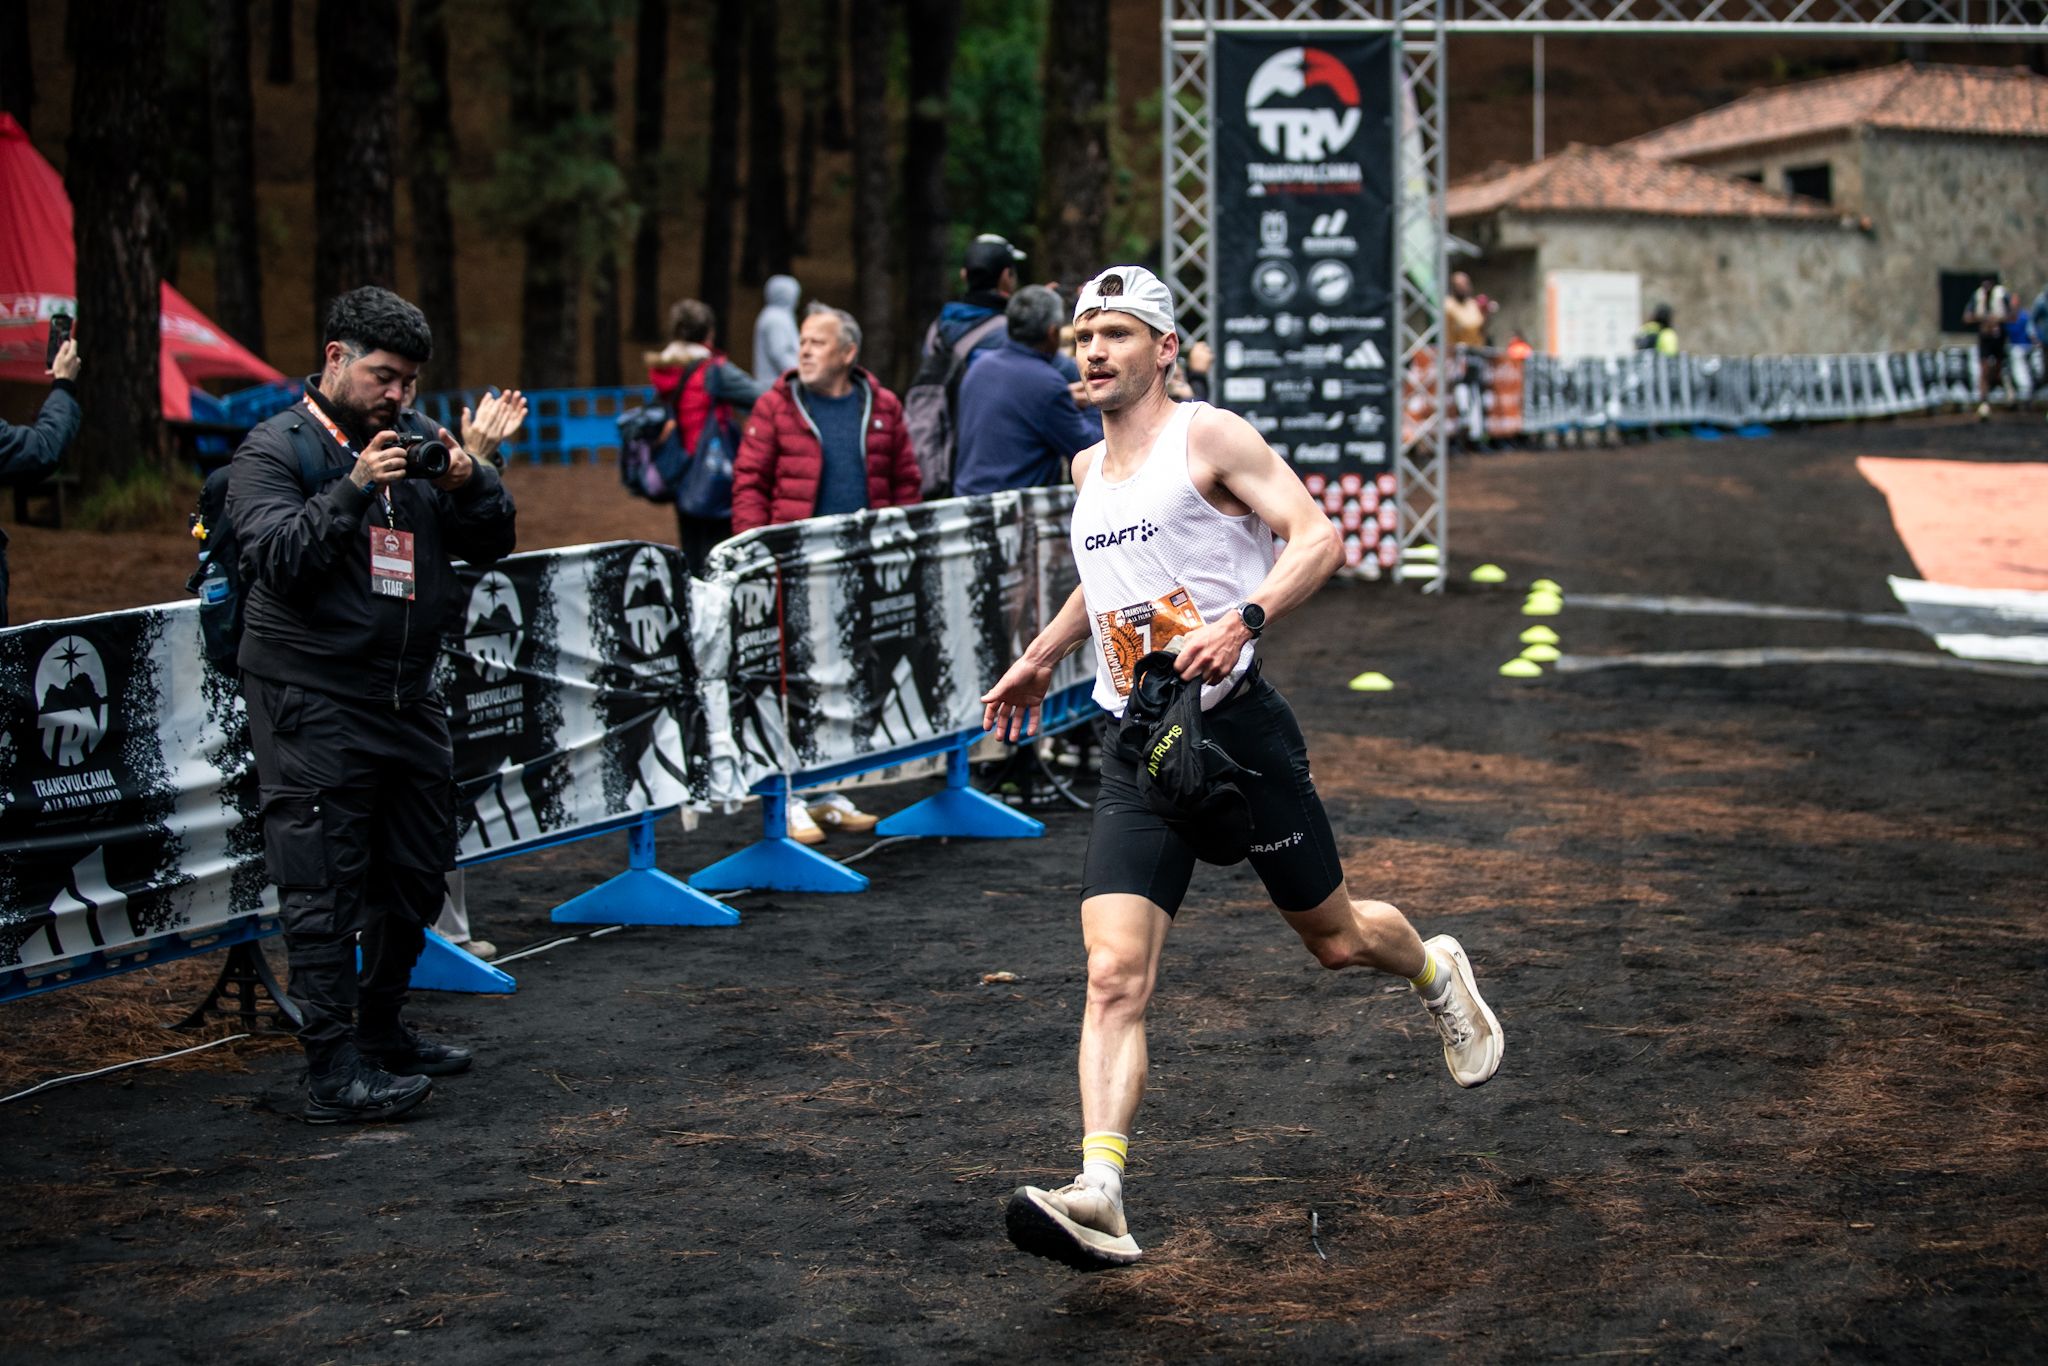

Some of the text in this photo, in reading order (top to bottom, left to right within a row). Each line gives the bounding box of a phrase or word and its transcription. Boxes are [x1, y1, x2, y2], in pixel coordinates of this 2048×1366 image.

[1085, 525, 1138, 551] CRAFT
[382, 579, 404, 597] STAFF
[1098, 614, 1127, 689] ULTRAMARATHON
[32, 769, 116, 797] TRANSVULCANIA
[65, 794, 92, 808] PALMA
[92, 789, 122, 804] ISLAND
